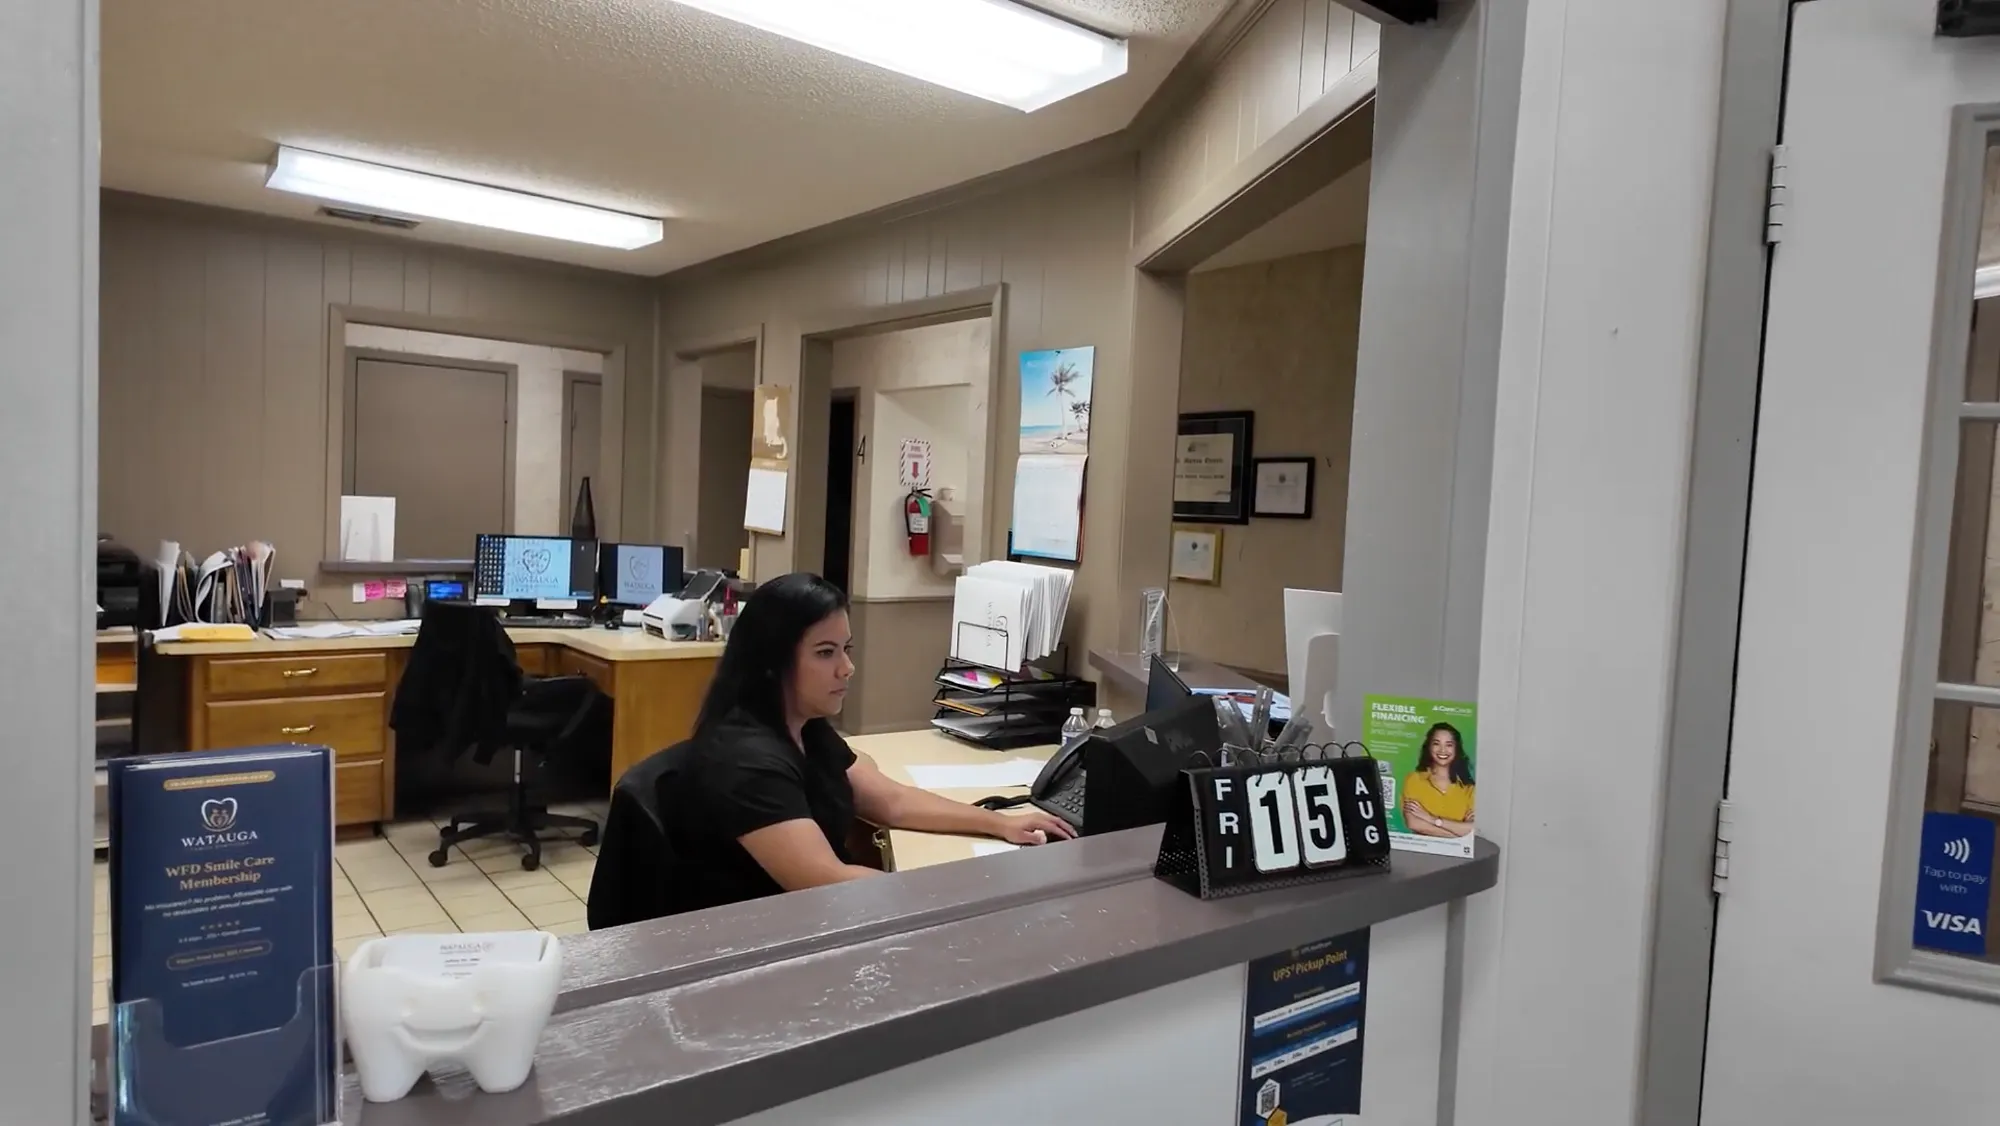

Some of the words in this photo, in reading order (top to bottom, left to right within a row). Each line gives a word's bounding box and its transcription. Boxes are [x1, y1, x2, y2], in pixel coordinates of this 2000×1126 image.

[856, 434, 867, 465] 4
[1372, 703, 1416, 714] FLEXIBLE
[1372, 712, 1425, 724] FINANCING
[1260, 784, 1335, 854] 15
[1355, 776, 1380, 844] AUG
[1214, 778, 1239, 869] FRI
[181, 830, 258, 848] WATAUGA
[165, 864, 201, 878] WFD
[203, 859, 241, 874] Smile
[244, 855, 276, 868] Care
[1923, 865, 1946, 878] Tap
[1948, 870, 1961, 880] to
[1963, 873, 1988, 885] pay
[180, 872, 261, 891] Membership
[1939, 883, 1968, 894] with
[1920, 909, 1982, 935] VISA
[1295, 957, 1325, 975] Pickup
[1325, 950, 1348, 966] Point
